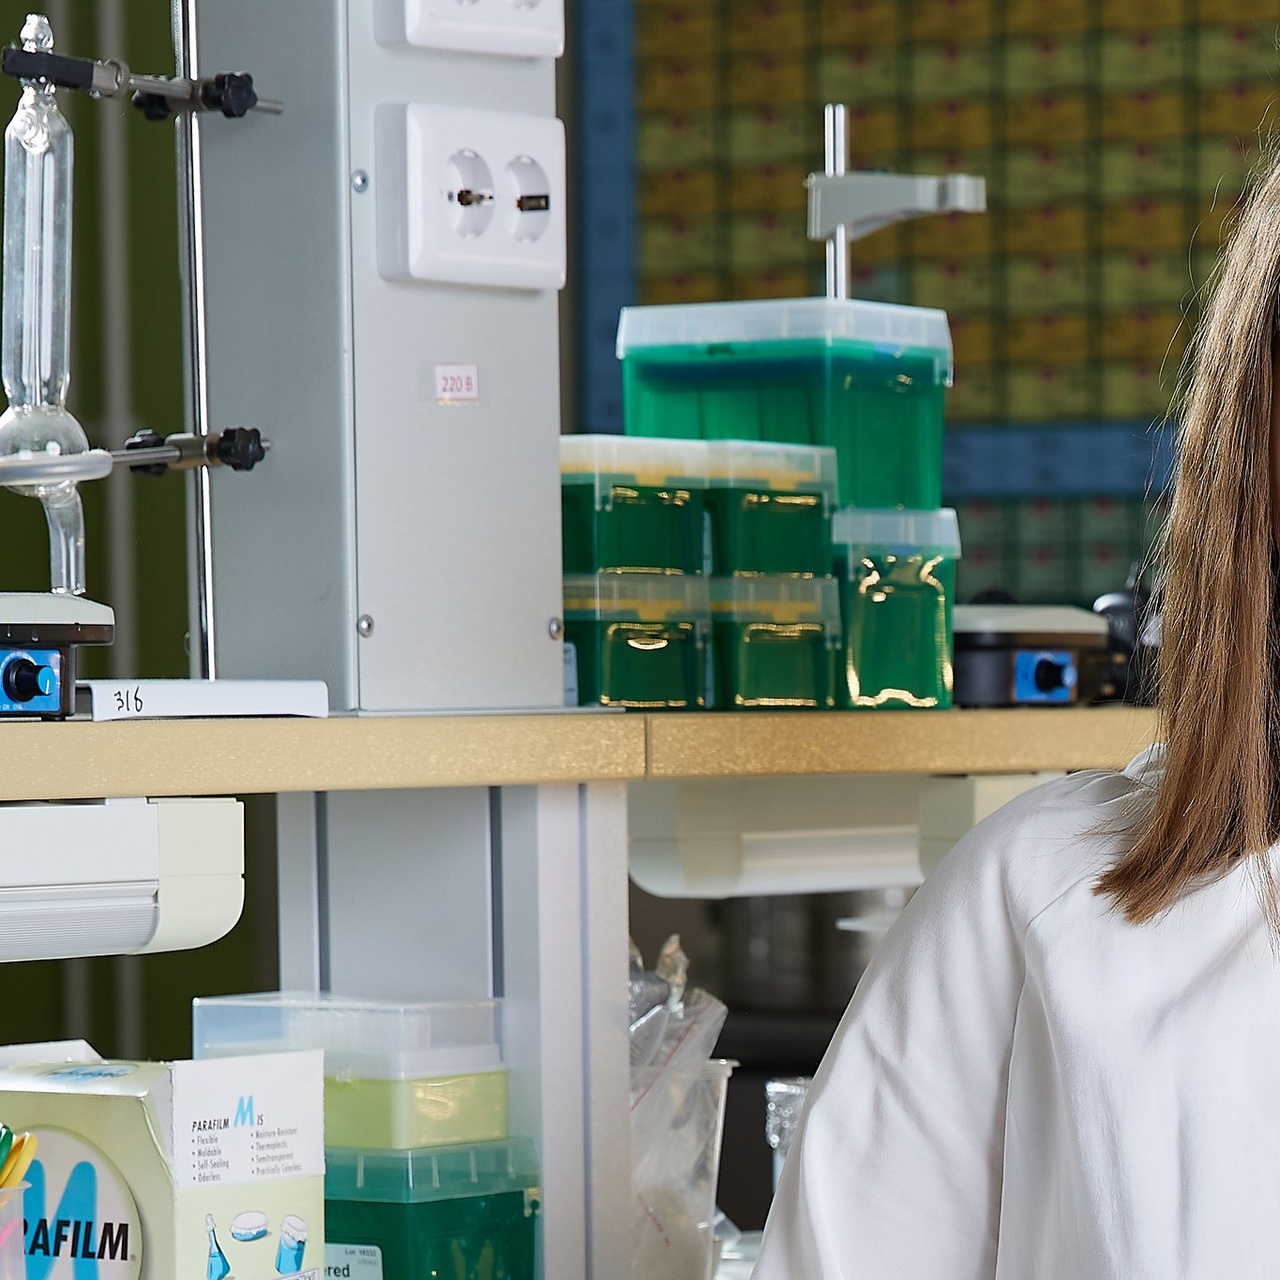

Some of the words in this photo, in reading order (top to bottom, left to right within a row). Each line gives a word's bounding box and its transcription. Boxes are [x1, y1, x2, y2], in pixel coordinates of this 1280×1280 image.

[442, 375, 463, 392] 220
[113, 686, 143, 712] 316
[192, 1118, 230, 1132] PARAFILM
[234, 1095, 255, 1128] M
[197, 1134, 218, 1145] Flexible
